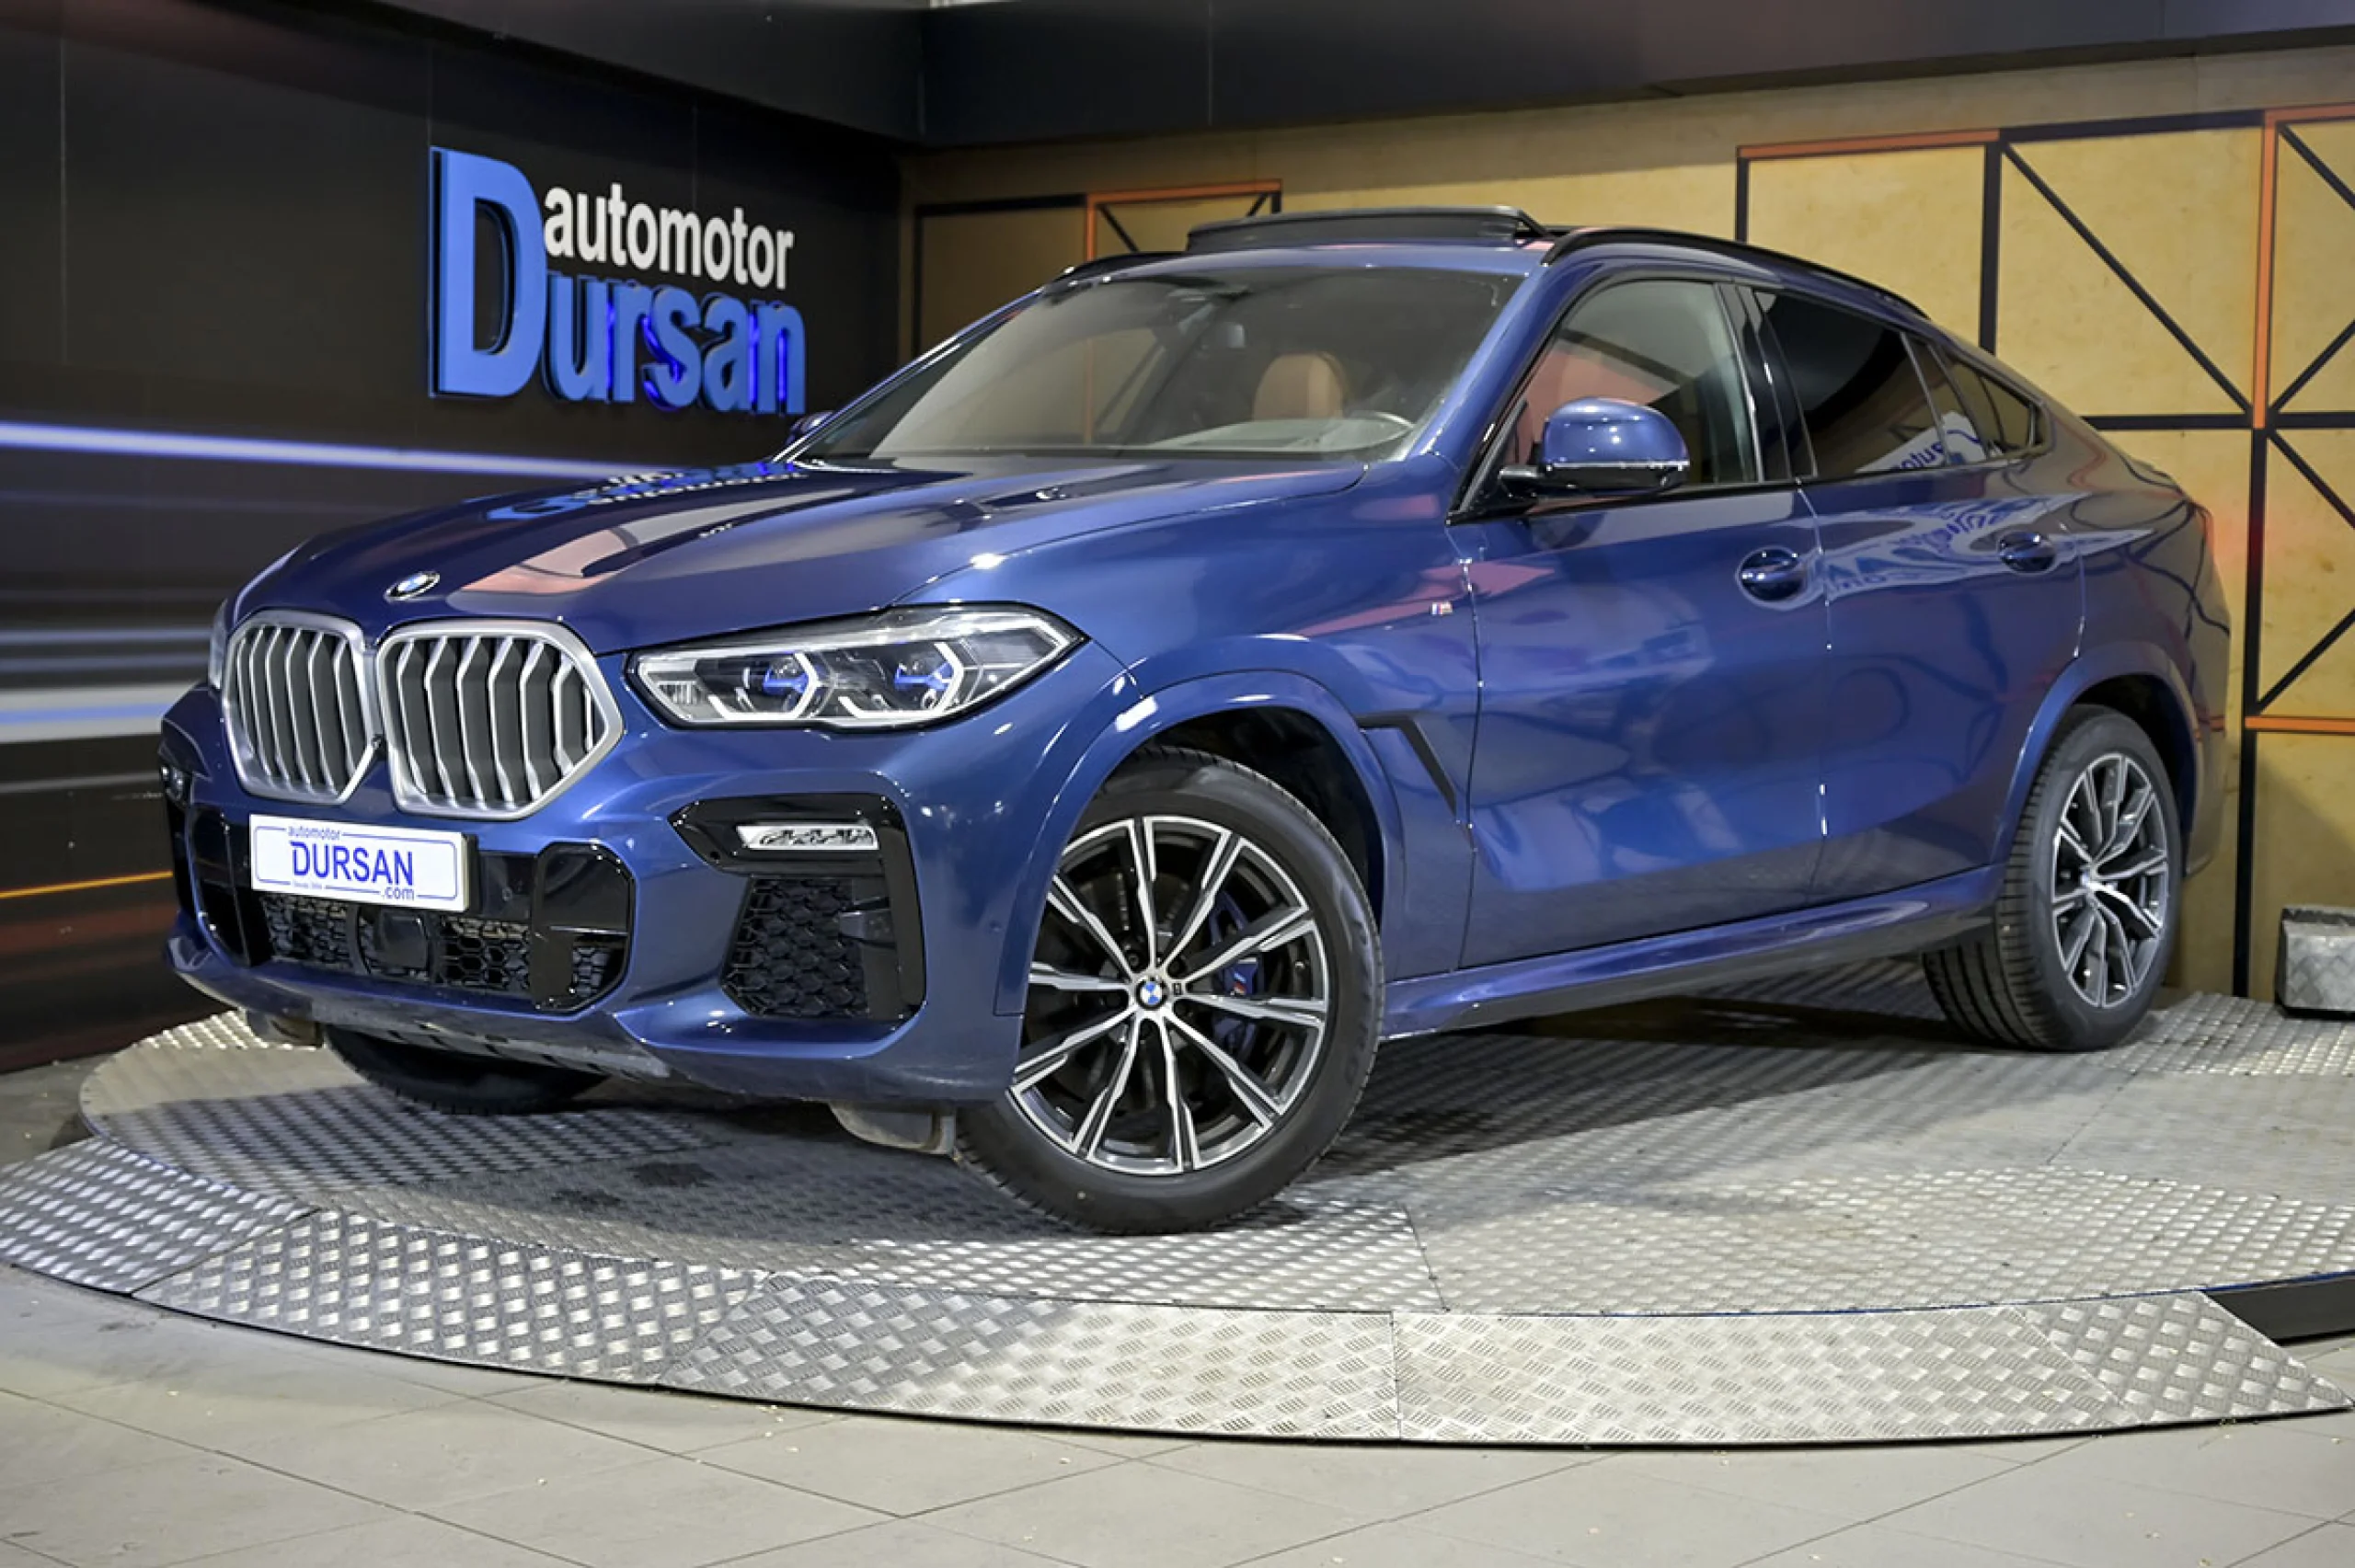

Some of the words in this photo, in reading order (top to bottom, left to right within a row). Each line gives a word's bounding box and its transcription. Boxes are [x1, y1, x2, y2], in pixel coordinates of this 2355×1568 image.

[544, 182, 794, 290] automotor
[430, 146, 806, 416] Dursan
[288, 826, 340, 841] automotor
[290, 841, 413, 886] DURSAN
[382, 887, 415, 901] .com
